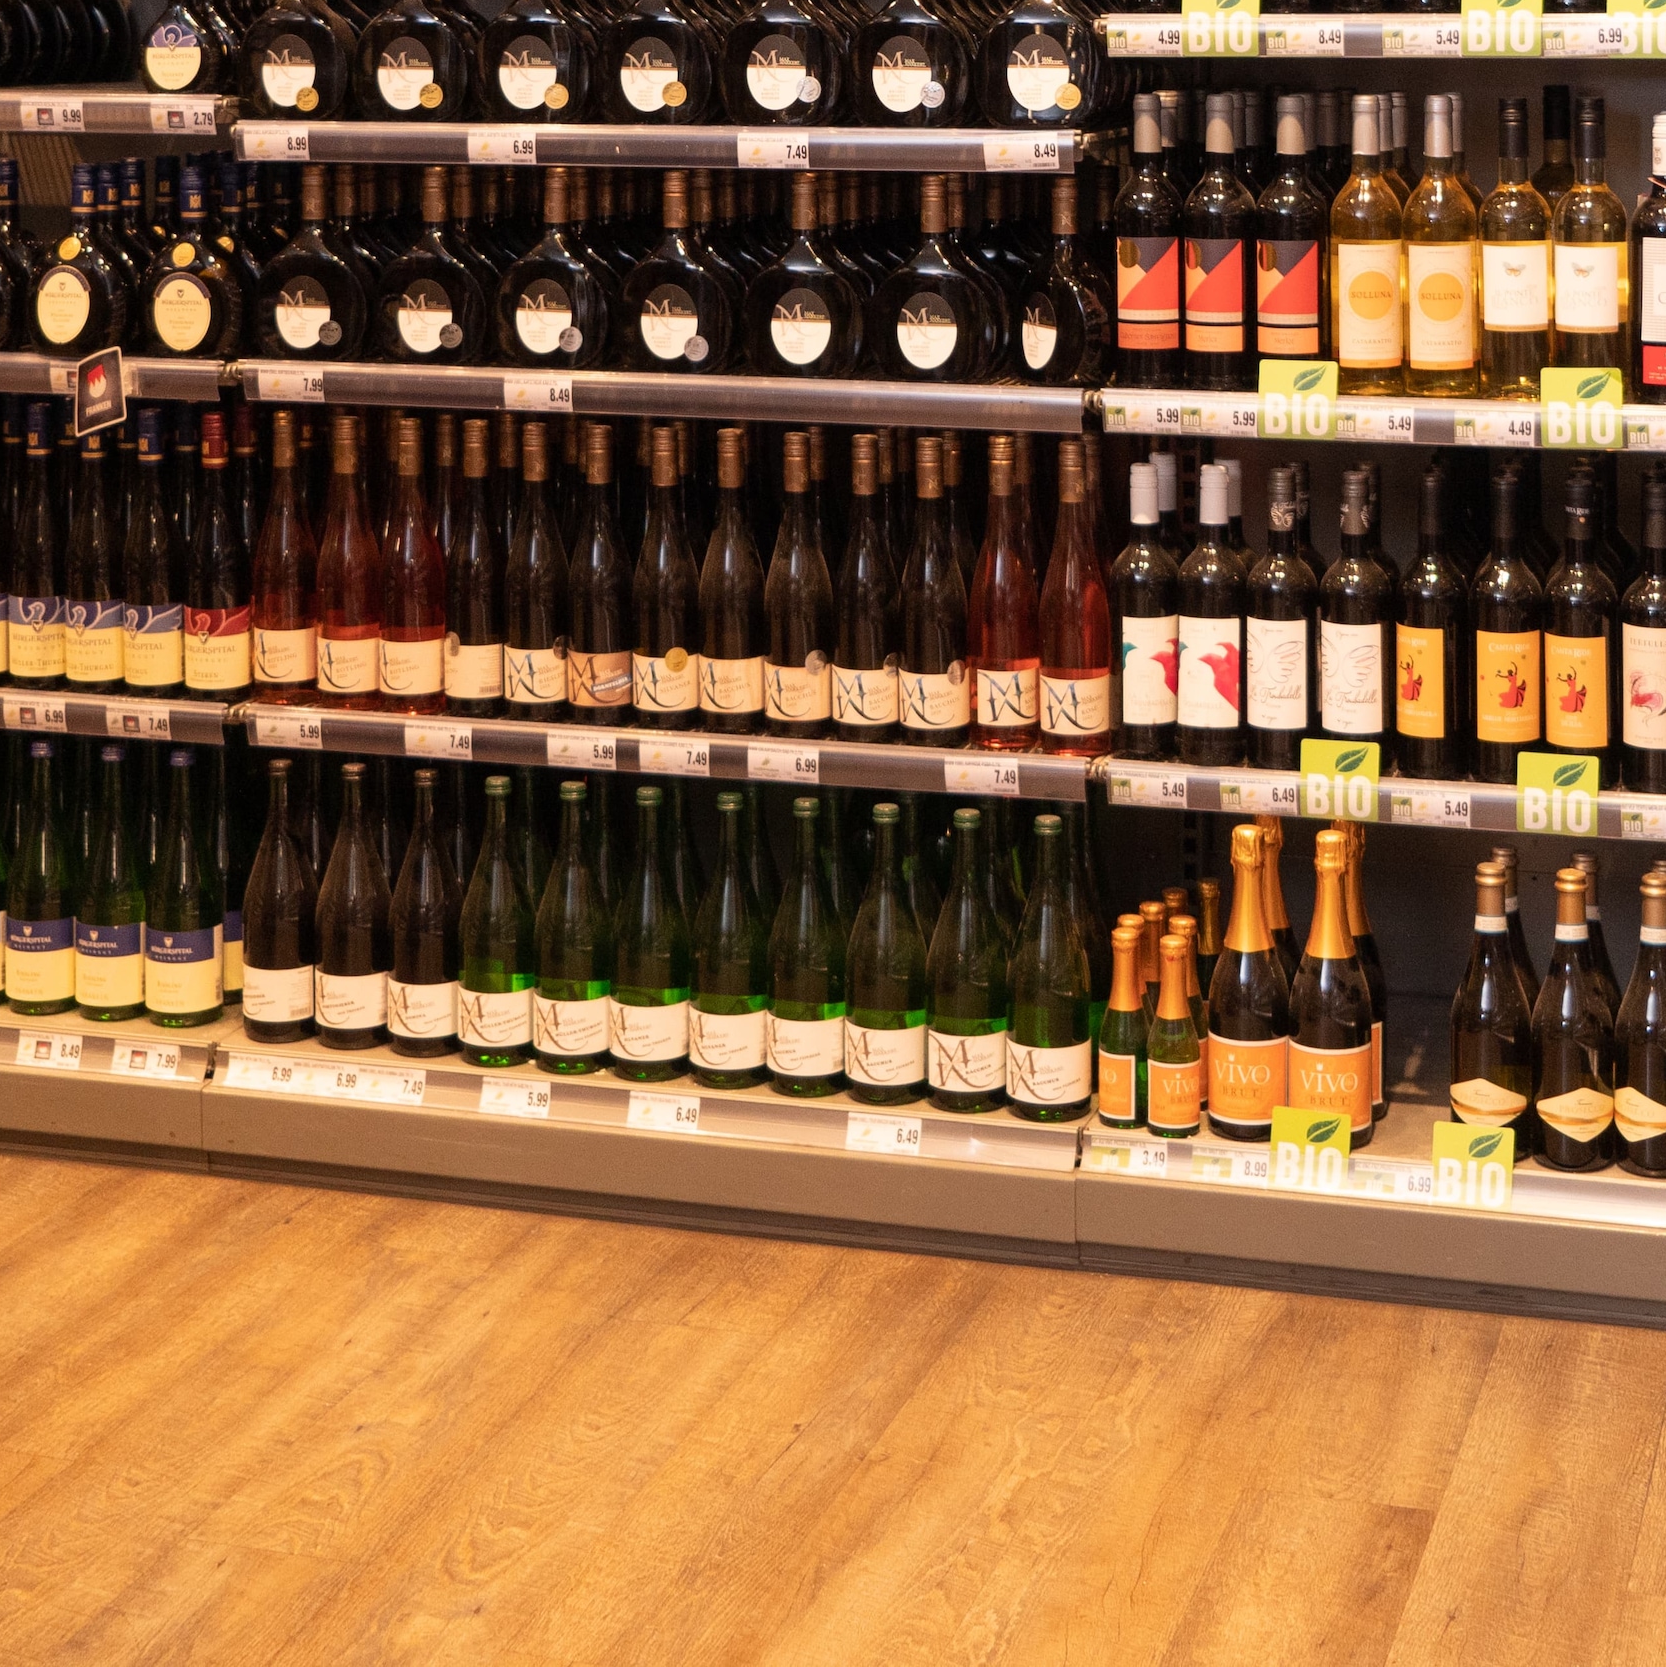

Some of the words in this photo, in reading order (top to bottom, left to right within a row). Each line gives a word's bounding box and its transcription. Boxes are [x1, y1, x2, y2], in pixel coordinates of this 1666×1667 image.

[1158, 30, 1180, 46] 4.99
[1187, 11, 1252, 54] BIO
[1318, 28, 1342, 45] 8.49
[1436, 29, 1459, 45] 5.49
[1467, 10, 1536, 54] BIO
[1598, 27, 1622, 44] 6.99
[1545, 37, 1563, 51] BIO
[785, 144, 807, 161] 7.49
[1033, 141, 1056, 159] 8.49
[302, 377, 323, 394] 7.99
[86, 400, 112, 417] FRANKEN
[1265, 393, 1329, 437] BIO
[1182, 413, 1200, 426] BIO
[1233, 411, 1256, 427] 5.99
[1388, 415, 1411, 431] 5.49
[1548, 402, 1615, 446] BIO
[1508, 420, 1532, 436] 4.49
[45, 709, 64, 724] 6.99
[1162, 782, 1184, 798] 5.49
[1272, 787, 1295, 803] 6.49
[1307, 774, 1372, 819] BIO
[1393, 804, 1411, 817] BIO
[1445, 801, 1468, 817] 5.49
[1524, 788, 1592, 833] BIO
[157, 1053, 176, 1068] 7.99
[272, 1067, 292, 1082] 6.99
[1214, 1060, 1272, 1085] VIVO
[403, 1080, 423, 1095] 7.49
[1300, 1070, 1358, 1094] VIVO
[896, 1128, 918, 1145] 6.49
[1142, 1151, 1165, 1168] 3.49
[1276, 1142, 1344, 1191] BIO
[1244, 1160, 1267, 1178] 8.99
[1407, 1175, 1431, 1194] 6.99
[1438, 1160, 1507, 1208] BIO
